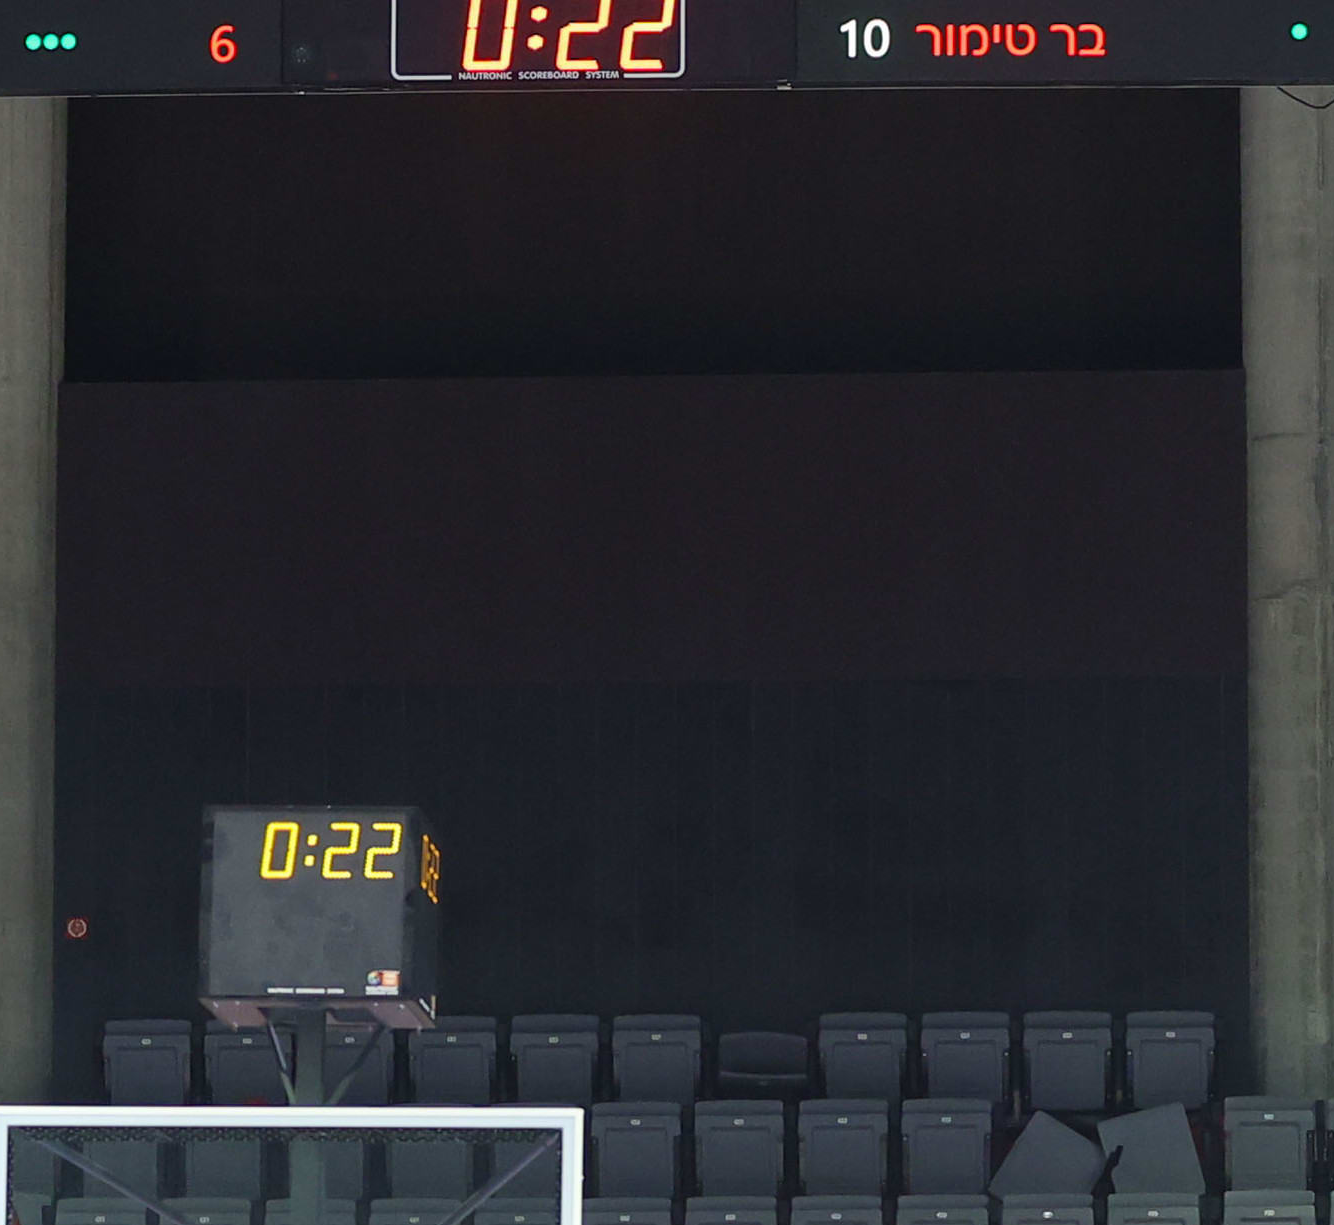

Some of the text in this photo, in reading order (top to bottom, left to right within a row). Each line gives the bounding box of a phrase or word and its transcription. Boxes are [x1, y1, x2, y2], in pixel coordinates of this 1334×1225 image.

[210, 26, 238, 64] 6
[462, 0, 676, 71] 0:22
[840, 20, 892, 59] 10
[916, 24, 1039, 58] טימור
[1050, 24, 1107, 58] בר
[458, 71, 620, 81] NAUTRONIC SCOREBOARD SYSTEM
[261, 822, 403, 880] 0:22
